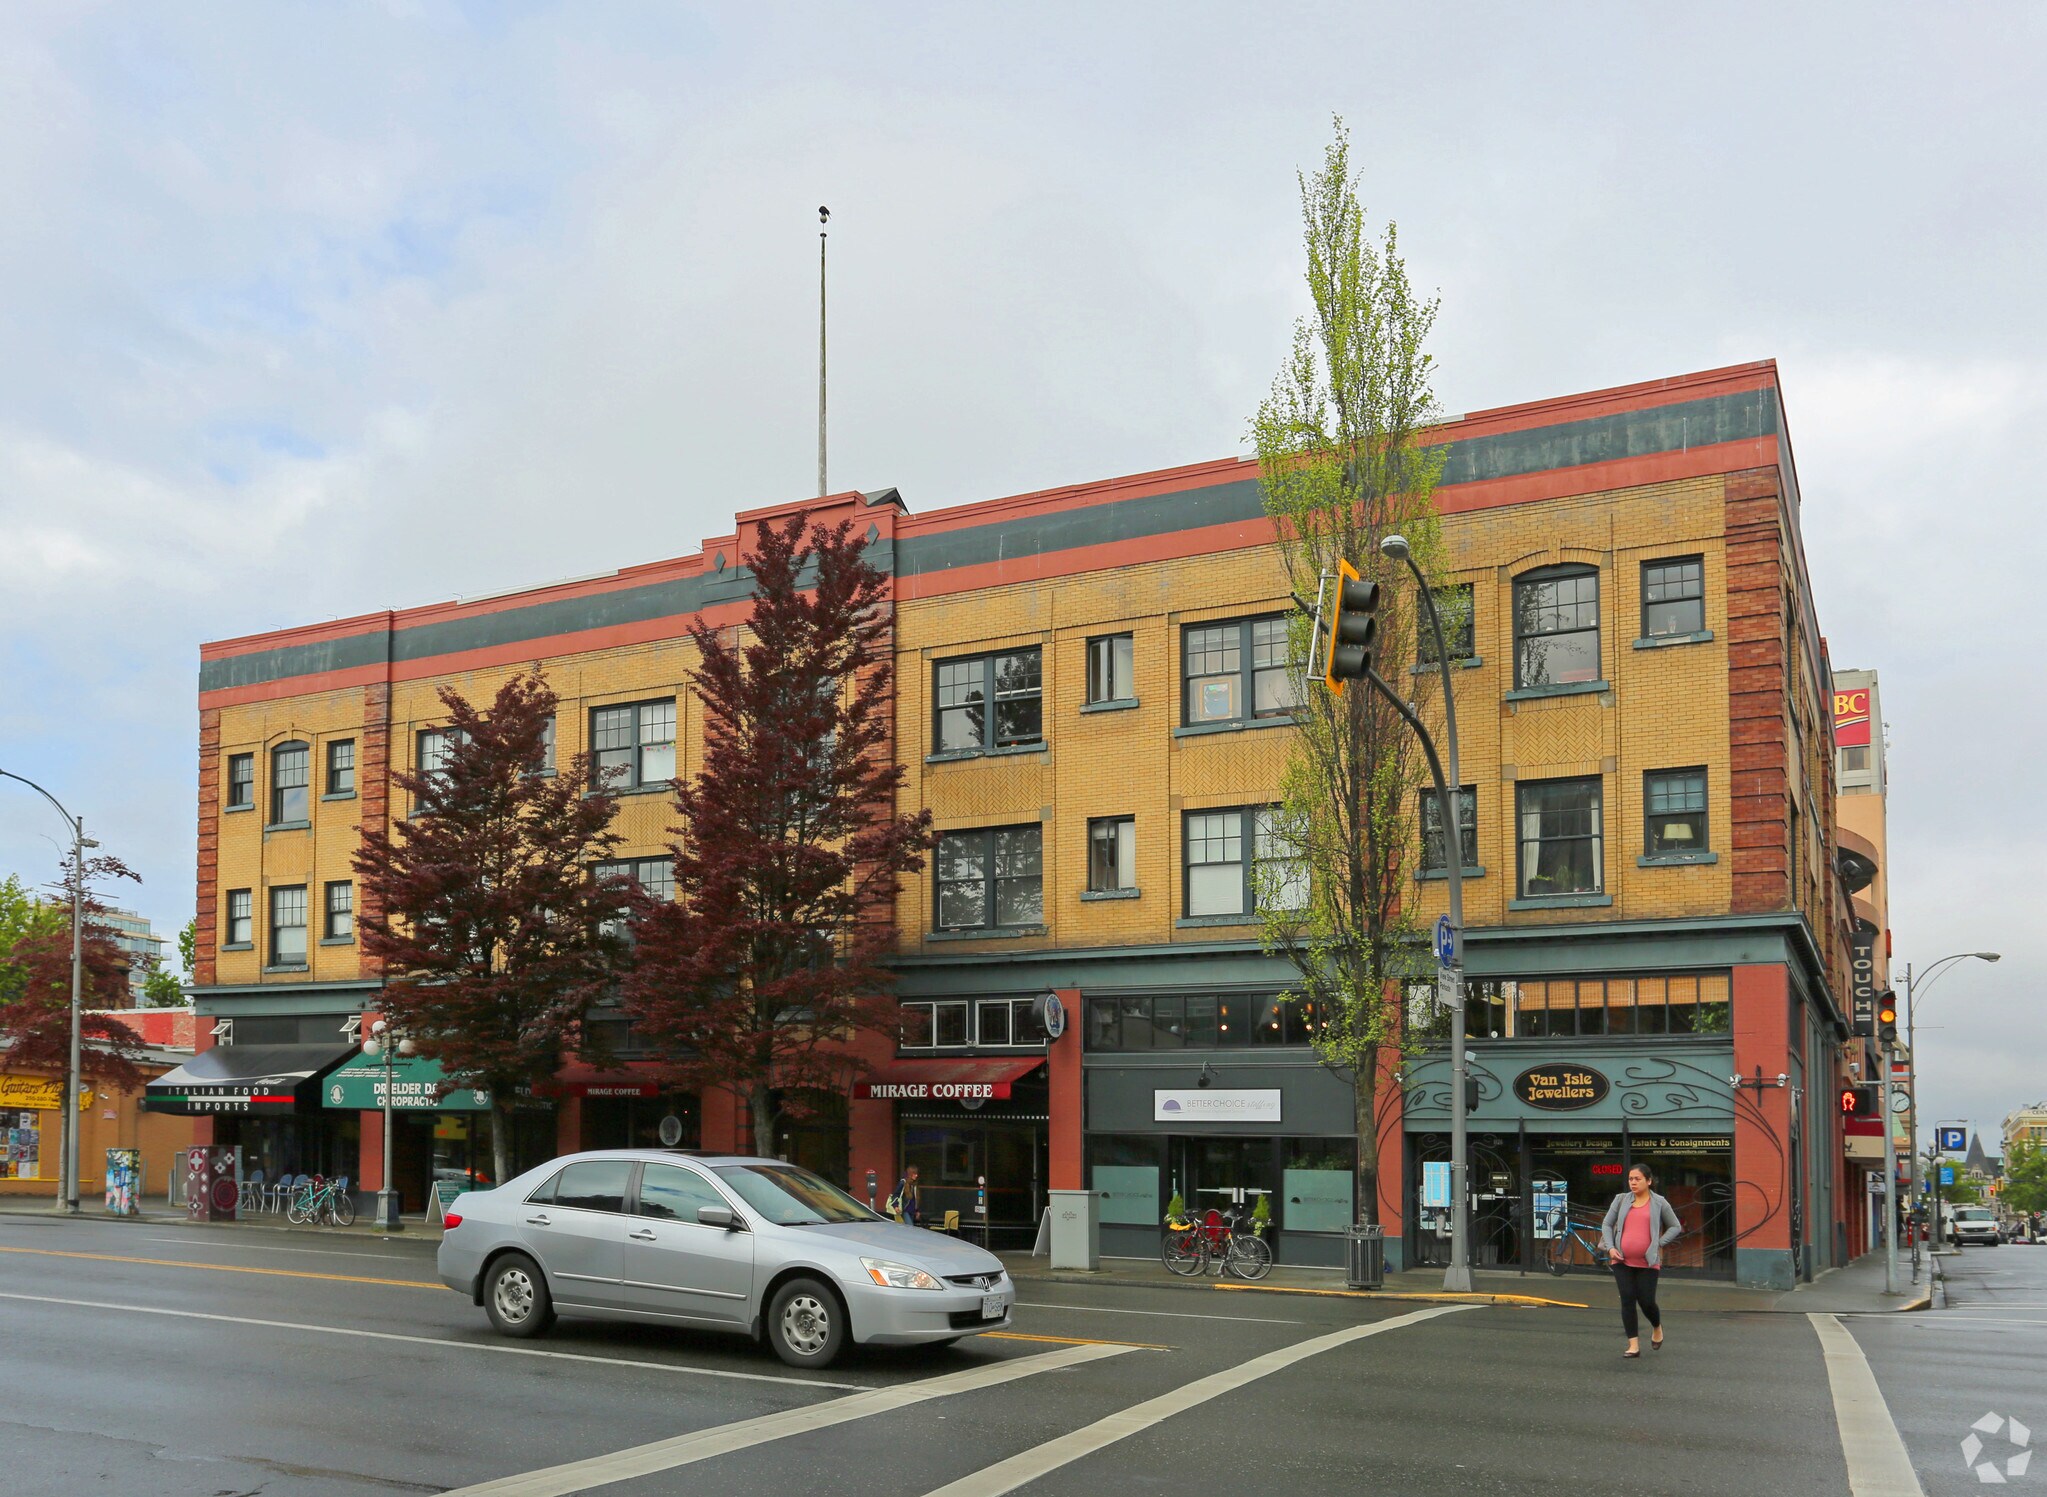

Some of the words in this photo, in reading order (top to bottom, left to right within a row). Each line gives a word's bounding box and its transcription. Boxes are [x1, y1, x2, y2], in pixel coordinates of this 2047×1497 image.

[1834, 692, 1866, 715] BC
[1529, 1074, 1558, 1086] Van
[1563, 1073, 1592, 1085] Isle
[1, 1076, 39, 1097] Guitars
[41, 1080, 65, 1094] Plu
[168, 1087, 224, 1096] ITALIAN
[234, 1087, 269, 1096] FOOD
[391, 1083, 422, 1095] ELDER
[587, 1088, 613, 1096] MIRAGE
[614, 1088, 641, 1096] COFFEE
[870, 1084, 928, 1098] MIRAGE
[932, 1084, 993, 1098] COFFEE
[1528, 1087, 1595, 1101] Jewellers
[187, 1102, 249, 1111] IMPORTS
[377, 1096, 439, 1107] CHROPRACTIC
[1546, 1140, 1583, 1149] Jewellery
[1586, 1140, 1613, 1148] Design
[1631, 1139, 1658, 1147] Estate
[1660, 1139, 1667, 1147] &
[1669, 1139, 1731, 1148] Consignments
[1947, 1131, 1962, 1147] P
[1591, 1164, 1624, 1175] CLOSED
